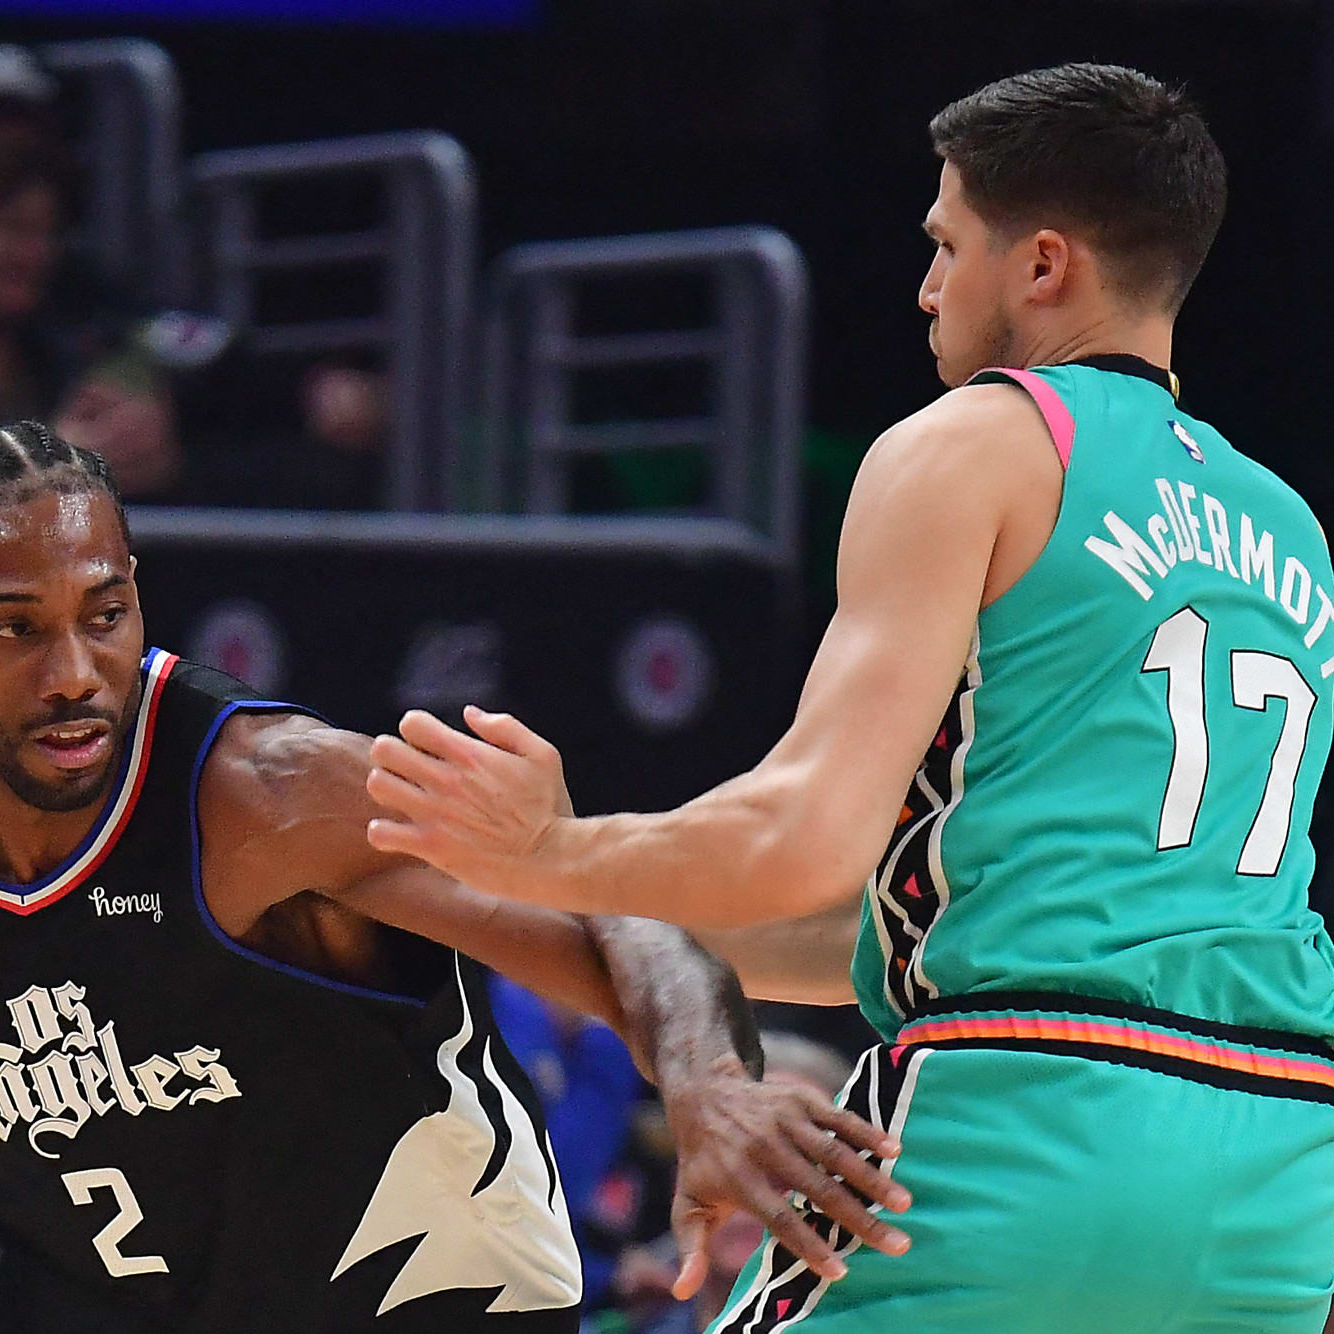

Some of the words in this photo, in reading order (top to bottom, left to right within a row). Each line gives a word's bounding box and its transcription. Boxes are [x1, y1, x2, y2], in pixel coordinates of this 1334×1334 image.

[1141, 605, 1317, 877] 17
[88, 886, 164, 923] honey
[60, 1167, 169, 1278] 2
